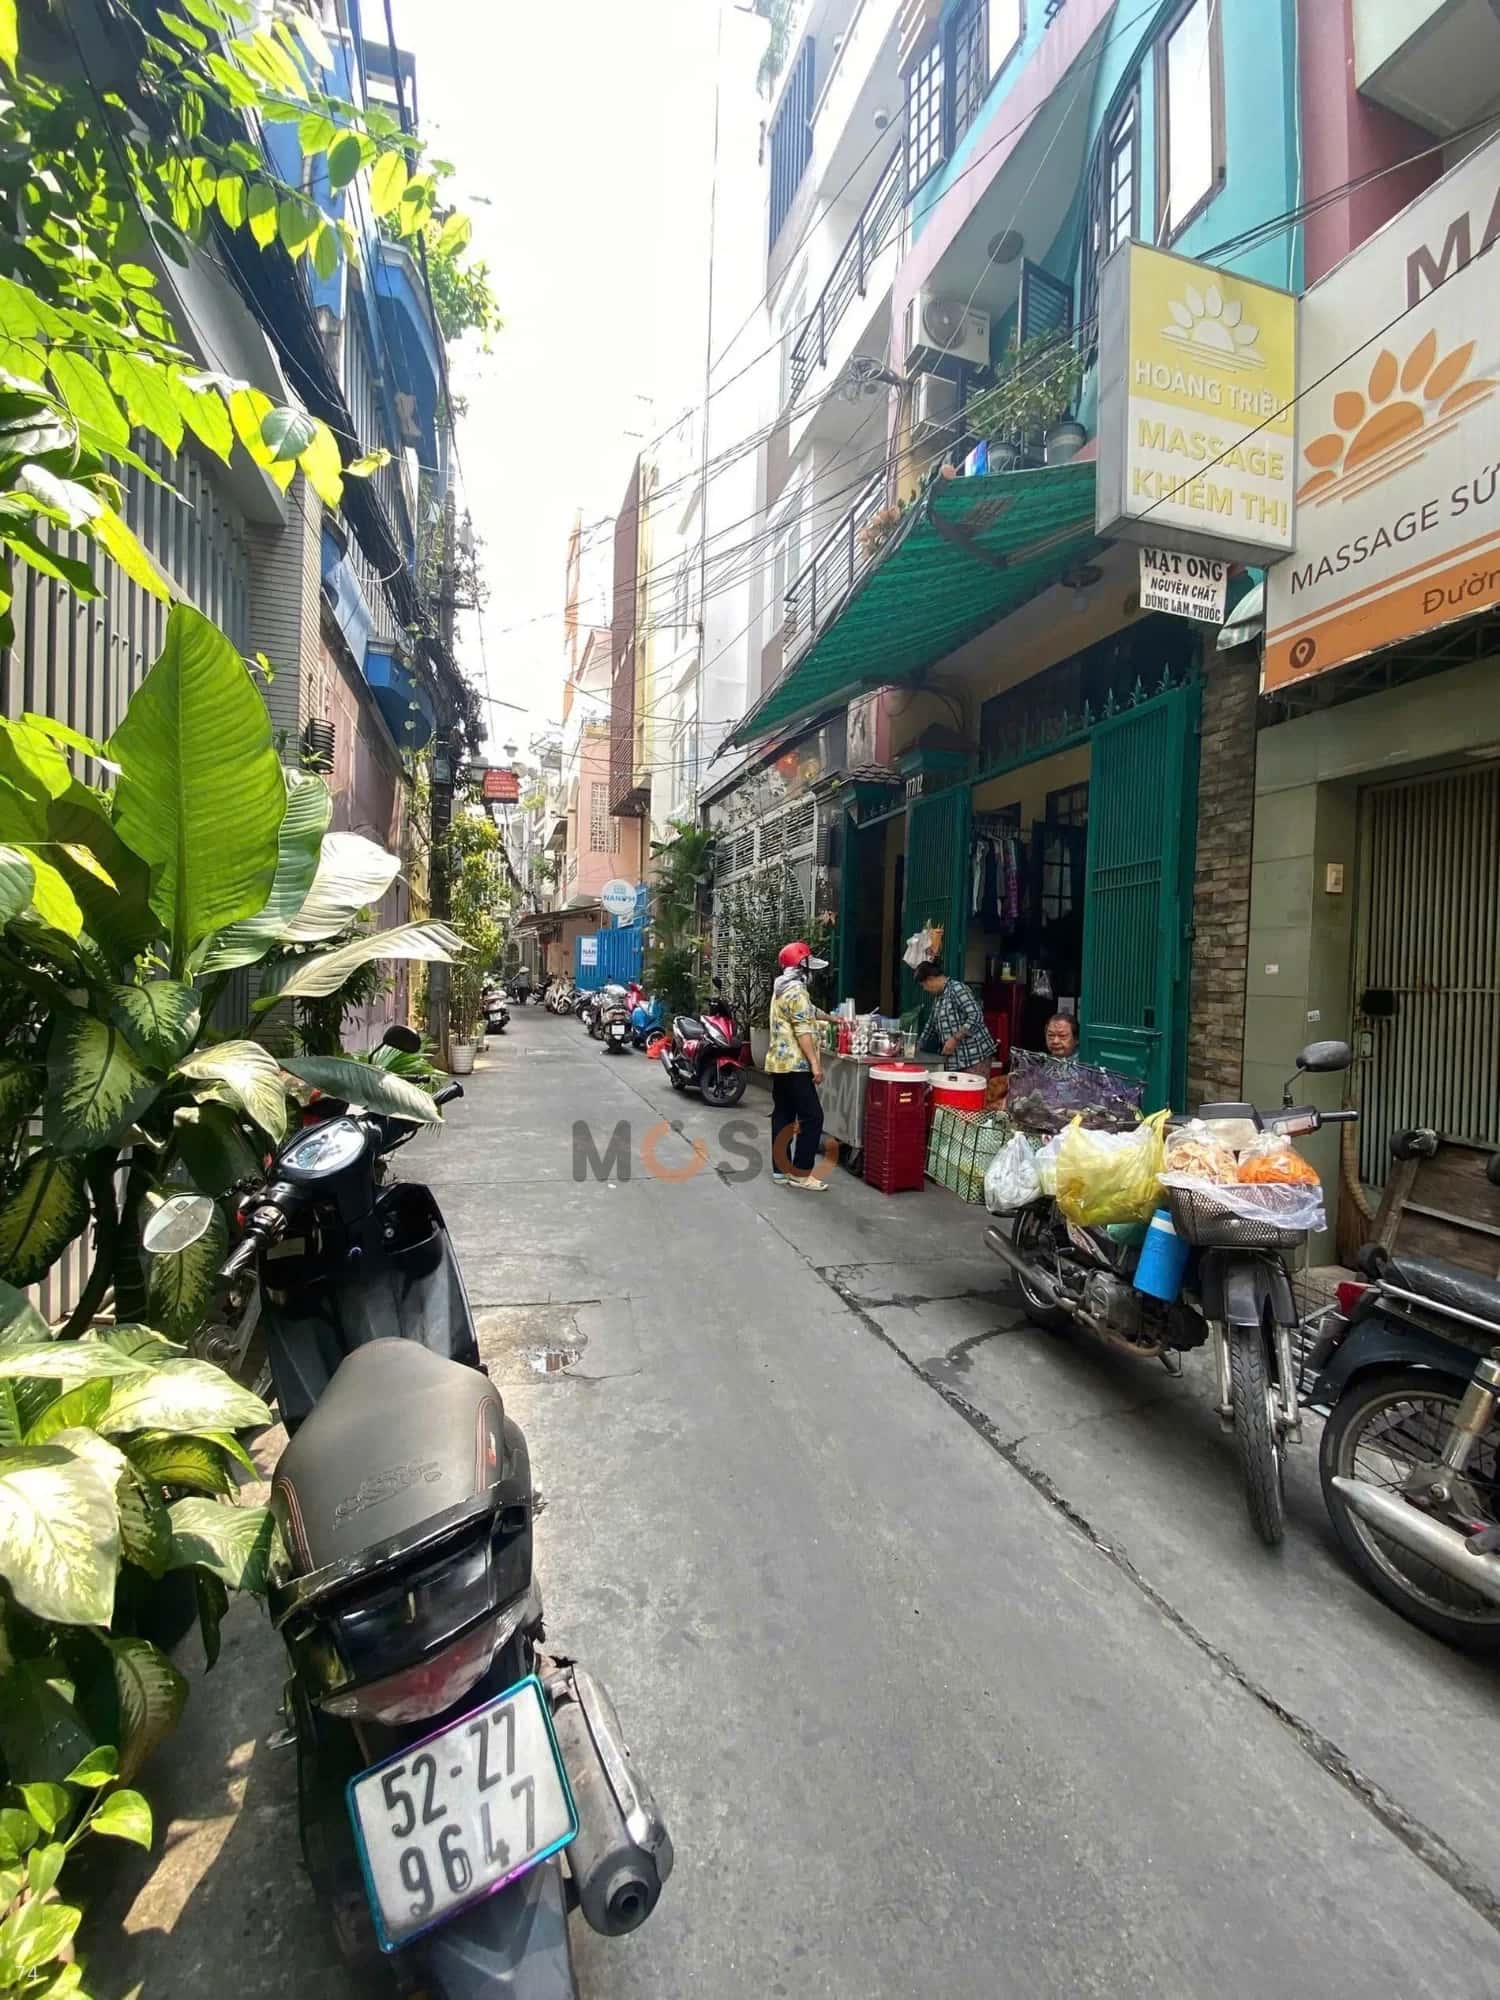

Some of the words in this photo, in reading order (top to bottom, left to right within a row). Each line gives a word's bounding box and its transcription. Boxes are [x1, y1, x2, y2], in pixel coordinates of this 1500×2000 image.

[1137, 417, 1284, 481] MASSAGE
[1240, 491, 1288, 537] THỊ
[1290, 499, 1439, 595] MASSAGE
[1186, 557, 1223, 582] ONG
[381, 1702, 516, 1838] 52-Z7
[399, 1774, 536, 1918] 9647
